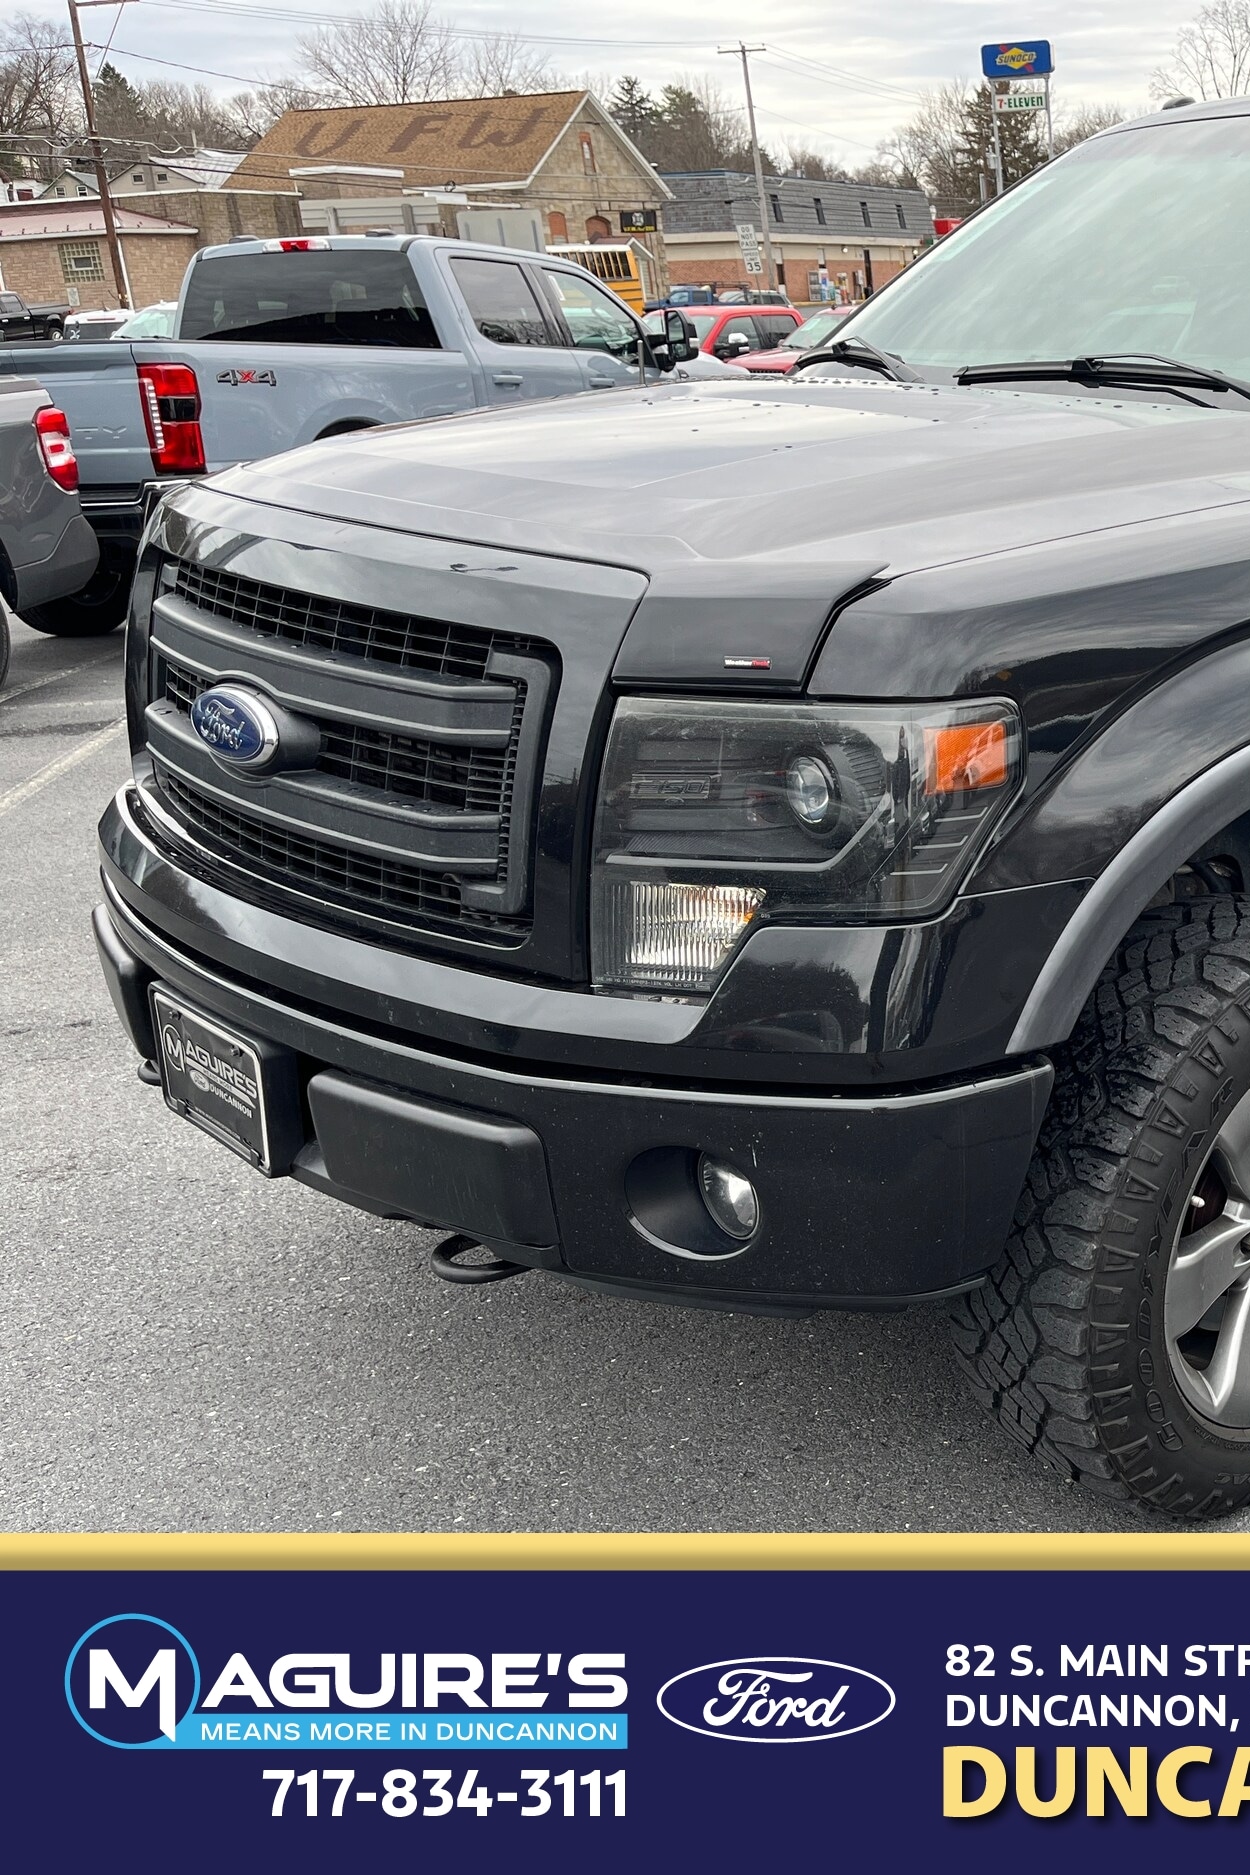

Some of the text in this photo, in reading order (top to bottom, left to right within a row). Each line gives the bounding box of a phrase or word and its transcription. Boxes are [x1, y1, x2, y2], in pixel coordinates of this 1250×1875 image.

[997, 52, 1035, 64] SUNOCO
[746, 261, 762, 272] 35
[200, 699, 243, 750] Ford
[166, 1032, 257, 1099] MAGUIRE'S
[209, 1083, 253, 1119] DUNCANNON
